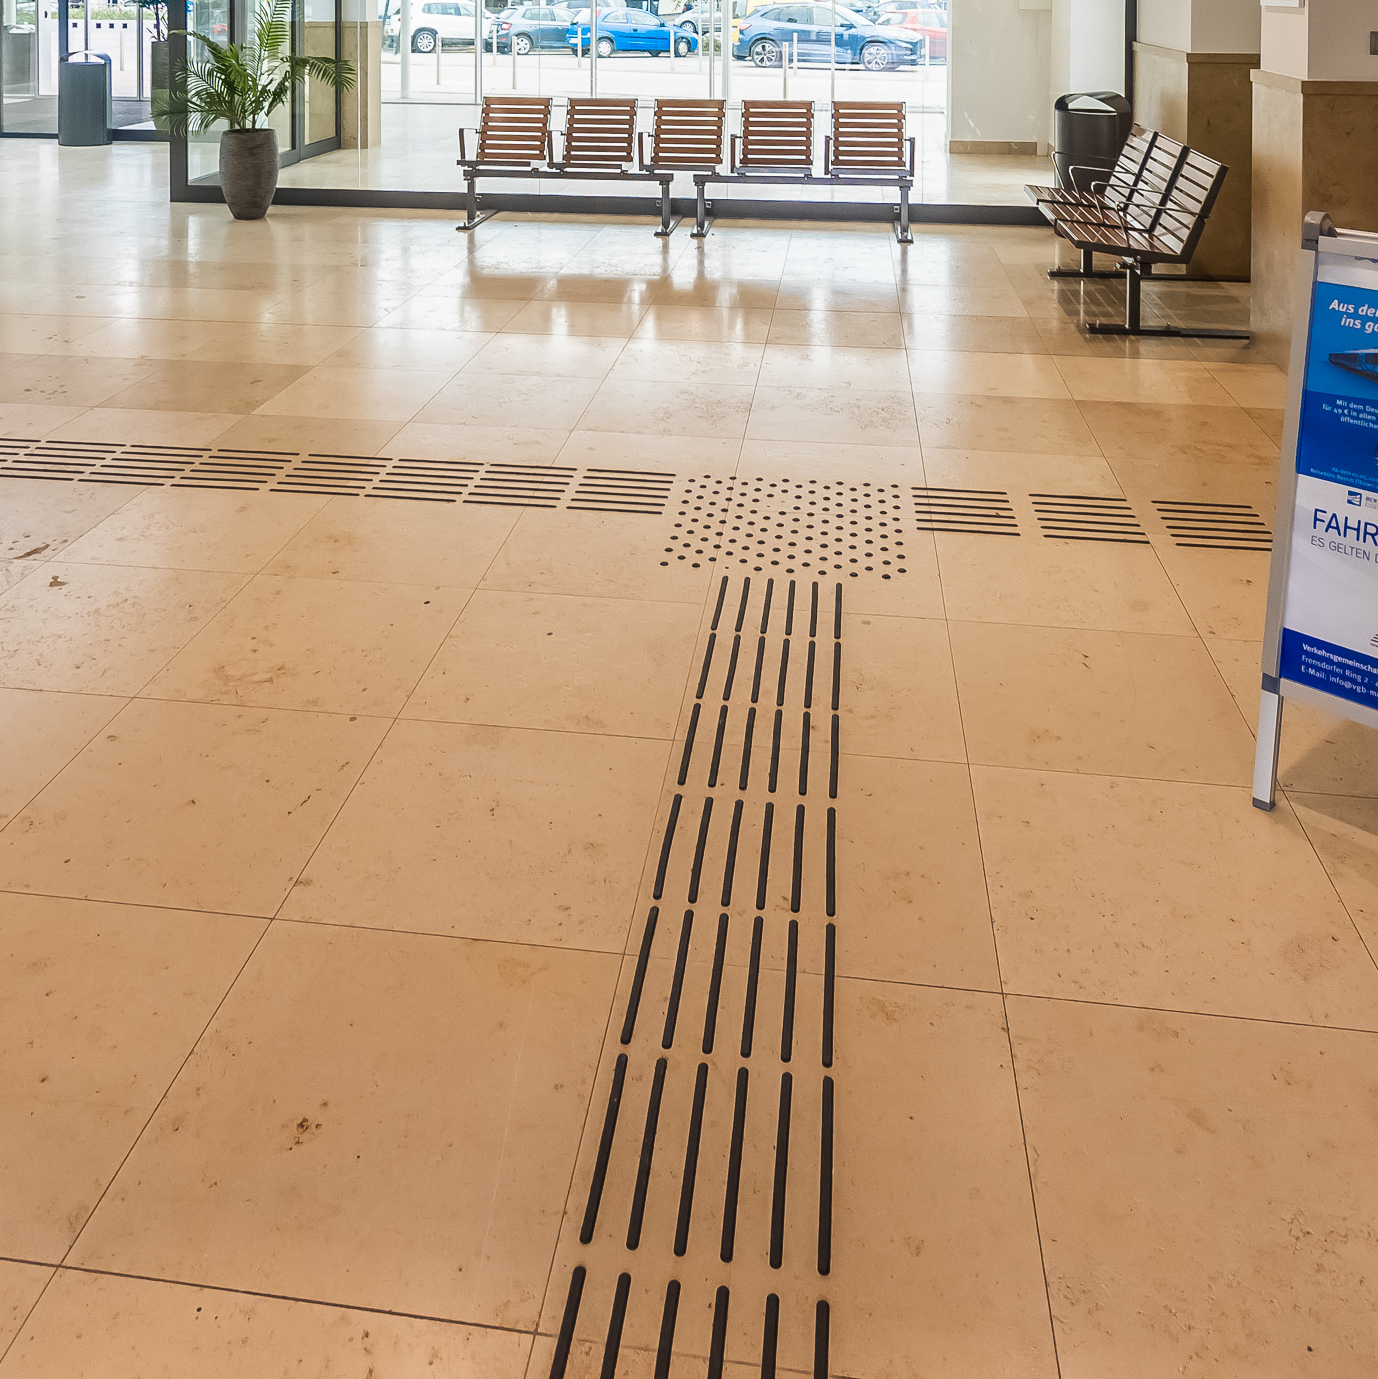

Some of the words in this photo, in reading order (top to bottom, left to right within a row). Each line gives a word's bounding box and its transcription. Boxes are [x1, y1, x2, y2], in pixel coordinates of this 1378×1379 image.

[1329, 299, 1355, 314] Aus
[1341, 315, 1361, 329] ins
[1322, 403, 1332, 411] für
[1359, 412, 1377, 421] allen
[1336, 399, 1348, 407] Mit
[1349, 402, 1364, 410] dem
[1310, 535, 1325, 548] ES
[1328, 539, 1371, 562] GELTEN
[1301, 654, 1343, 675] Frensdorfer
[1345, 669, 1362, 683] Ring
[1301, 665, 1327, 680] E-Mail:
